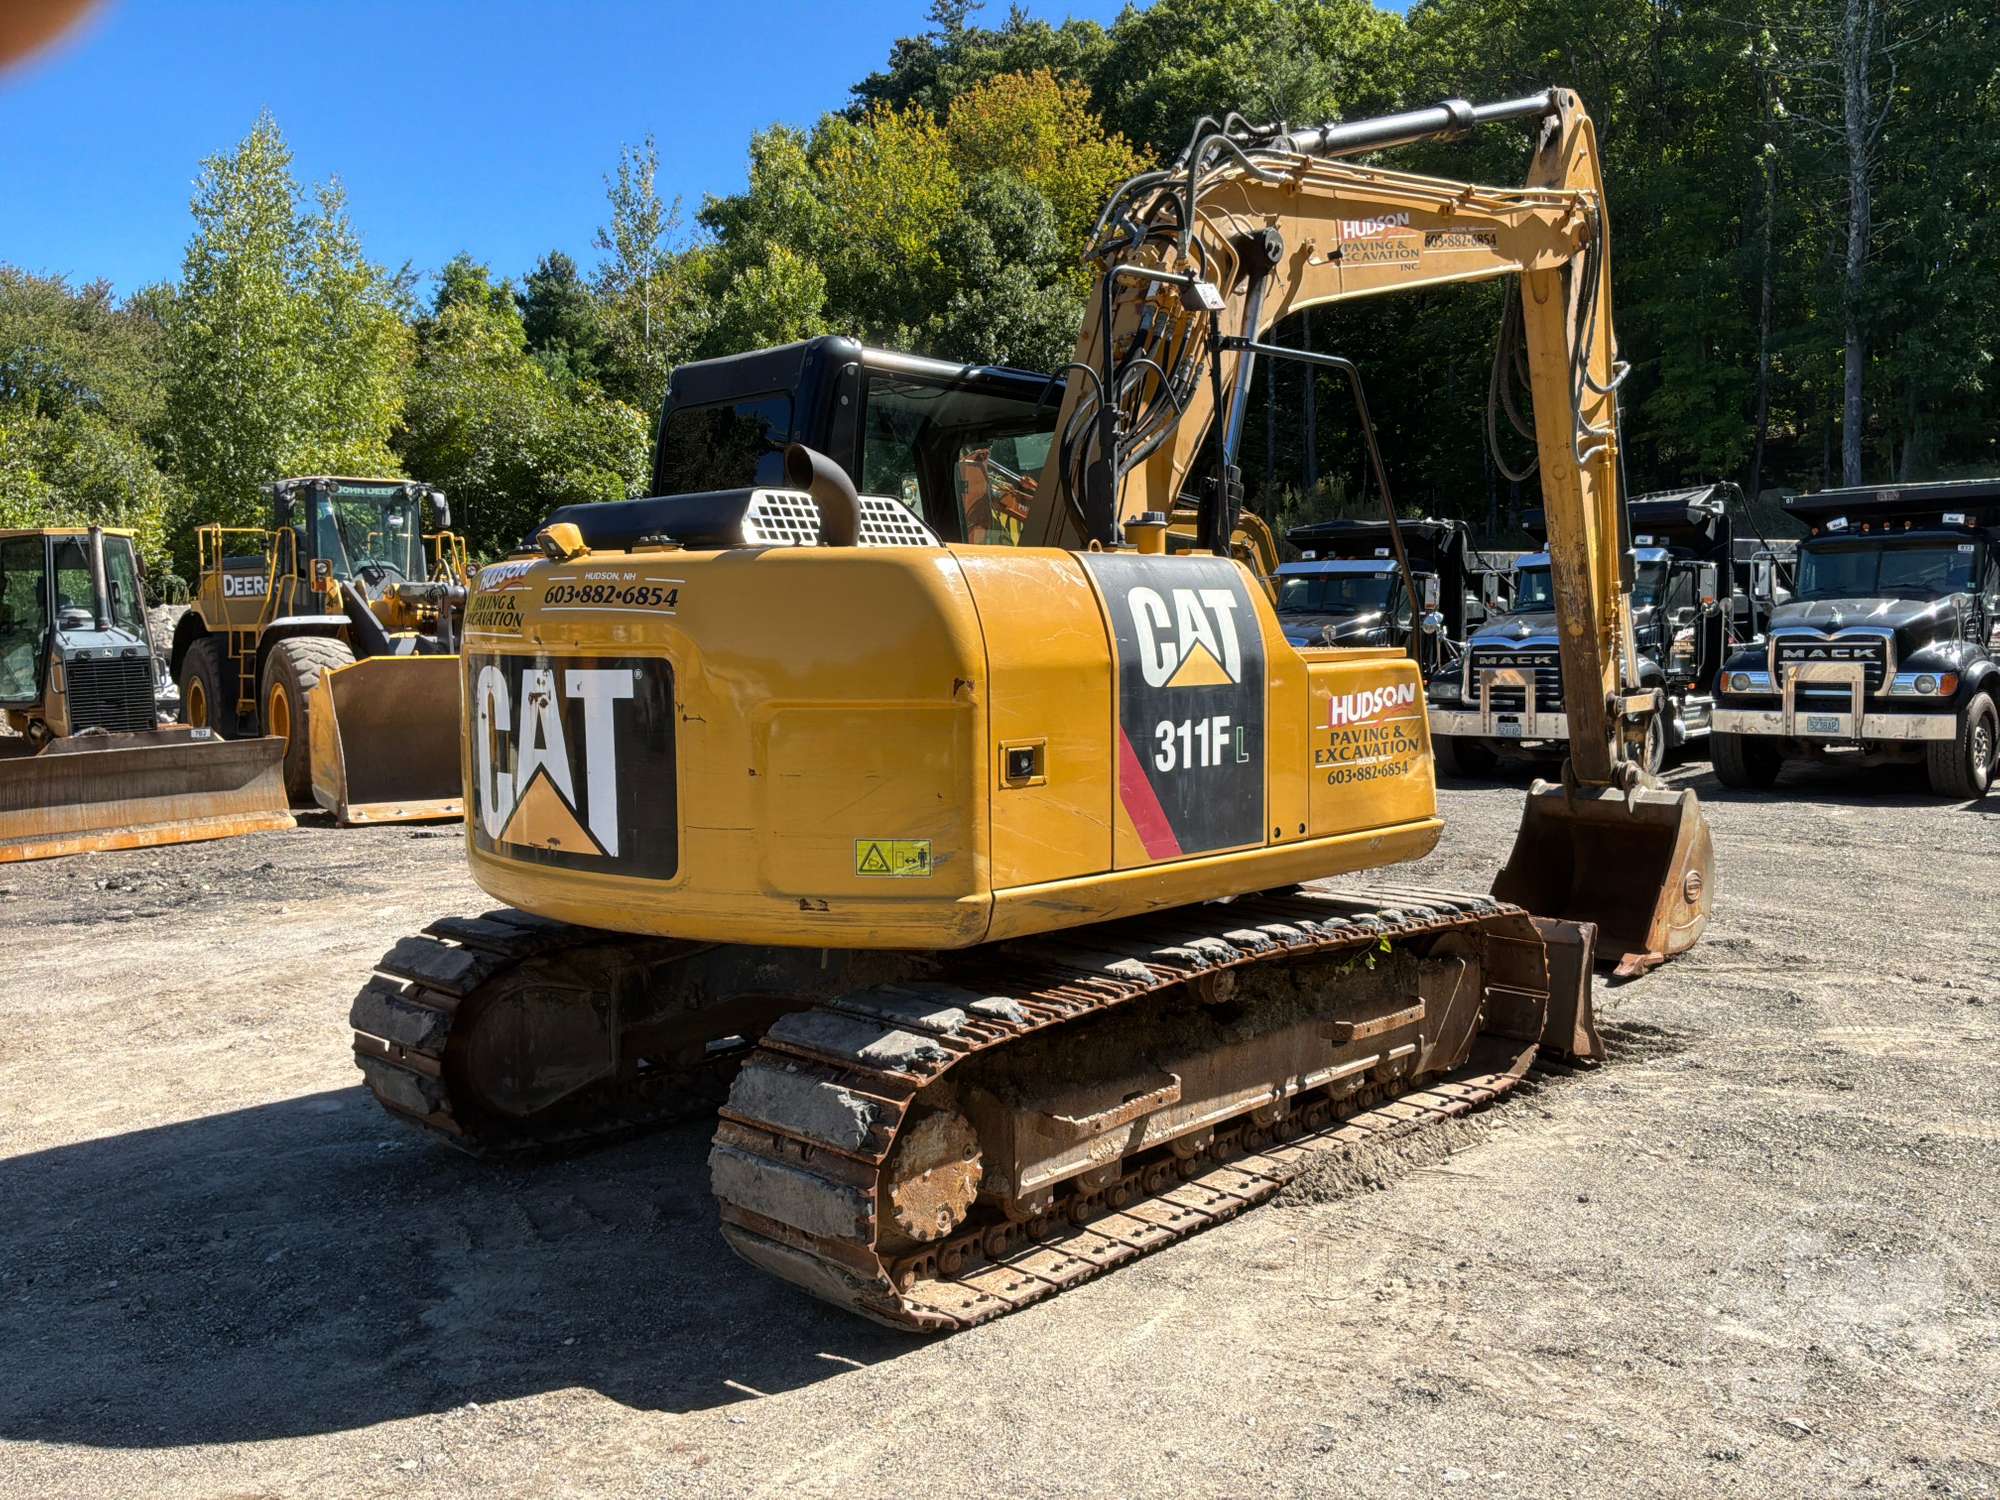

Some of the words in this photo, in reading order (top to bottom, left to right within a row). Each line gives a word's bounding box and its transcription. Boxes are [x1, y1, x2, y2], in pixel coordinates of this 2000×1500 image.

[1343, 212, 1409, 240] HUDSON
[1343, 241, 1393, 252] PAVING
[1397, 240, 1408, 249] &
[1343, 248, 1419, 261] XCAVATION
[367, 487, 396, 495] DEER
[223, 574, 269, 596] DEER
[479, 562, 529, 591] HUDSON
[623, 572, 637, 581] NH
[507, 595, 516, 610] &
[1129, 586, 1241, 688] CAT
[1480, 656, 1552, 665] MACK
[1782, 648, 1877, 658] MACK
[1329, 682, 1416, 727] HUDSON
[1155, 715, 1231, 773] 311F
[1330, 726, 1389, 746] PAVING
[1393, 724, 1404, 738] &
[477, 665, 634, 858] CAT
[1315, 738, 1419, 764] EXCAVATION
